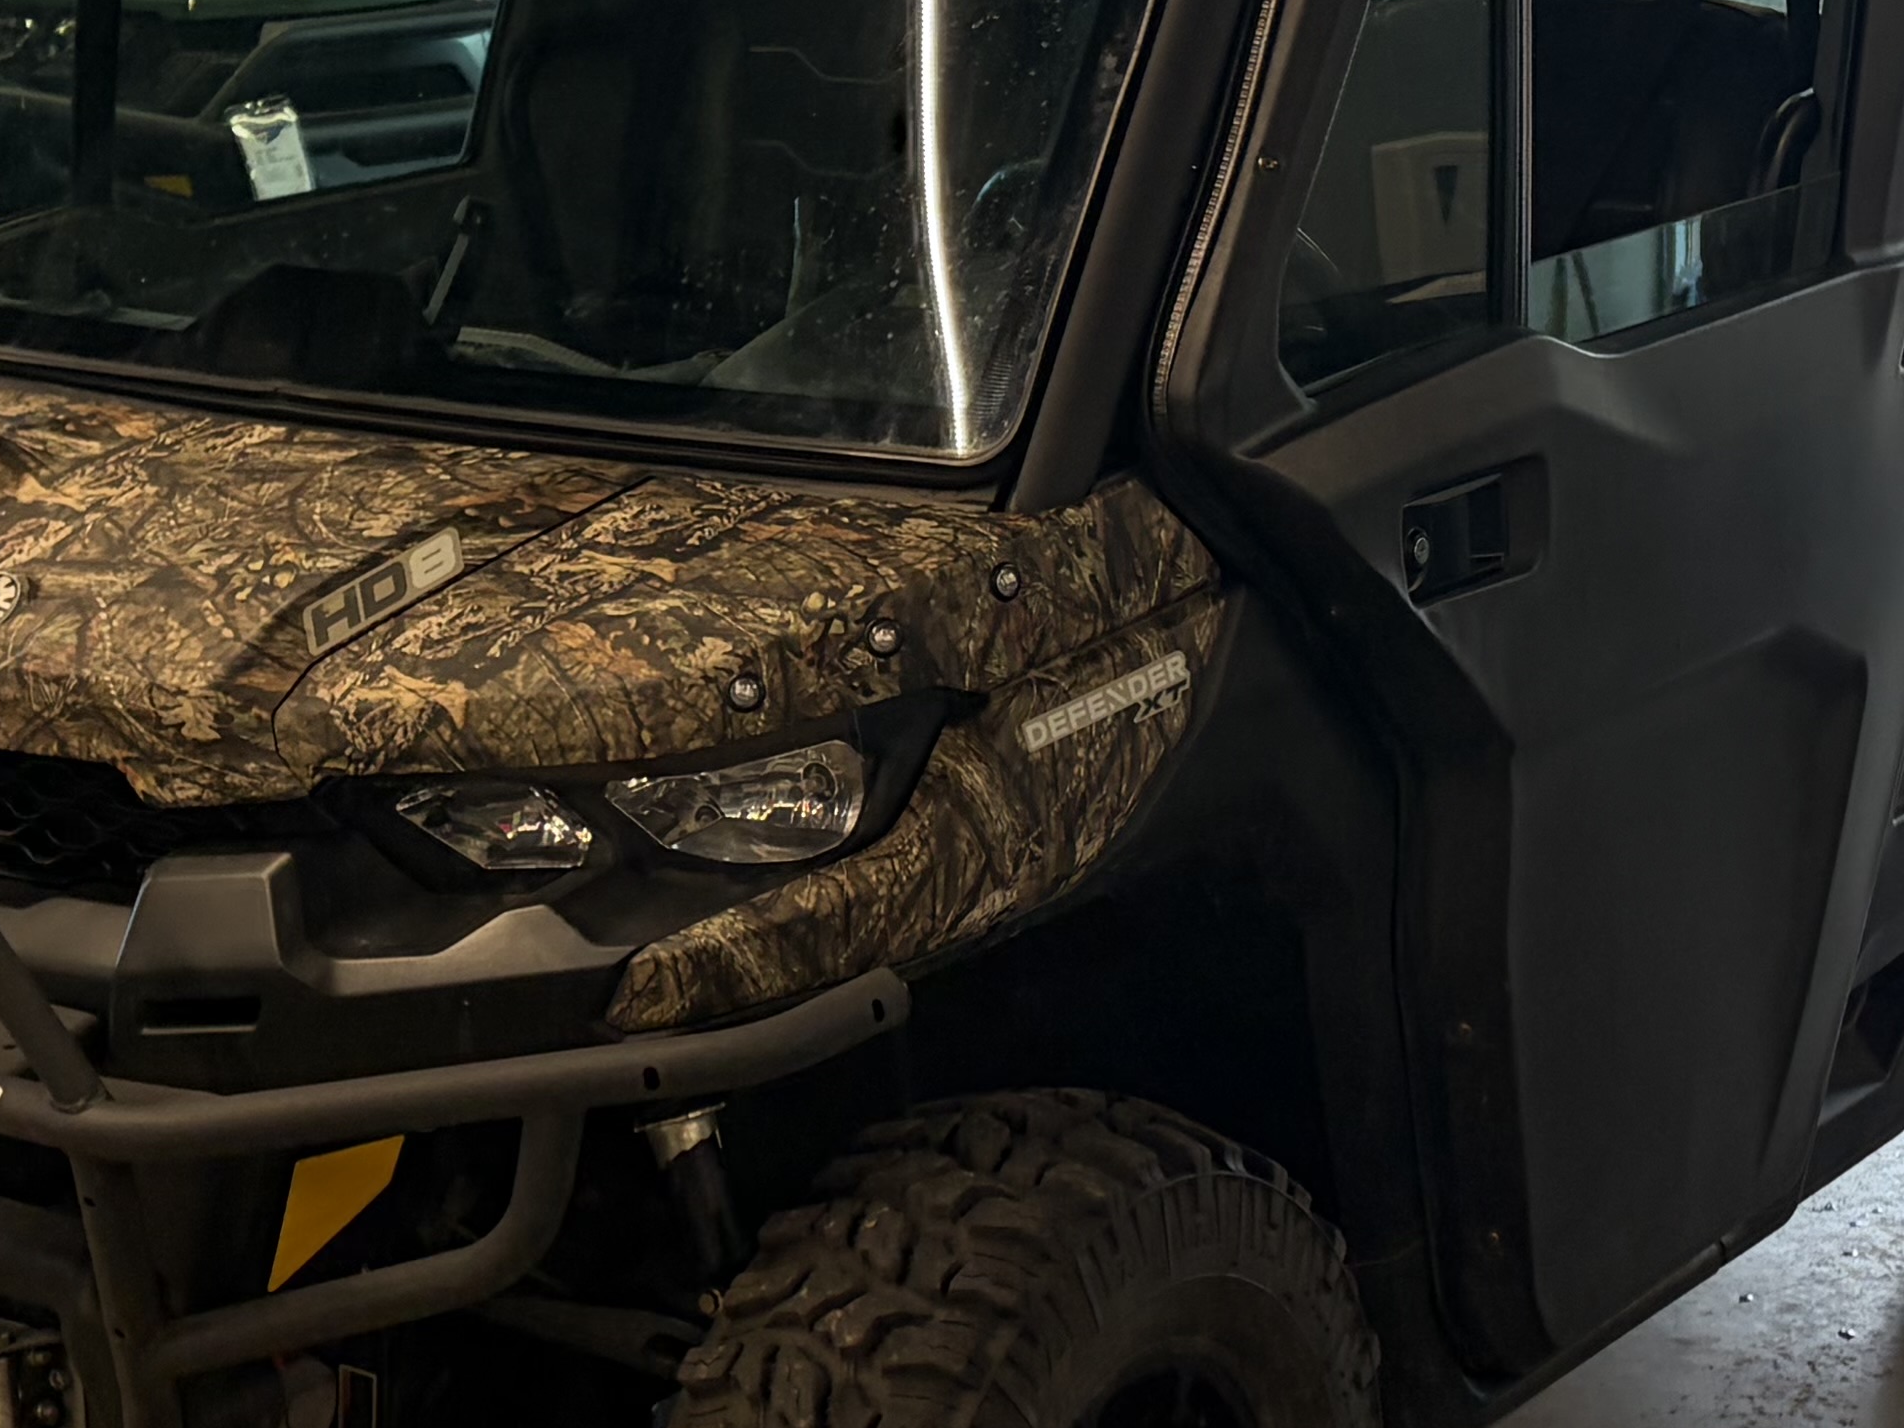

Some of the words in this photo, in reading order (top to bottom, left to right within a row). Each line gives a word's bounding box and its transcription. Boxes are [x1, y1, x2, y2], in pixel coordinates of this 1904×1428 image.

[310, 534, 456, 648] HD8
[1025, 654, 1187, 748] DEFENDER
[1141, 679, 1188, 715] XT
